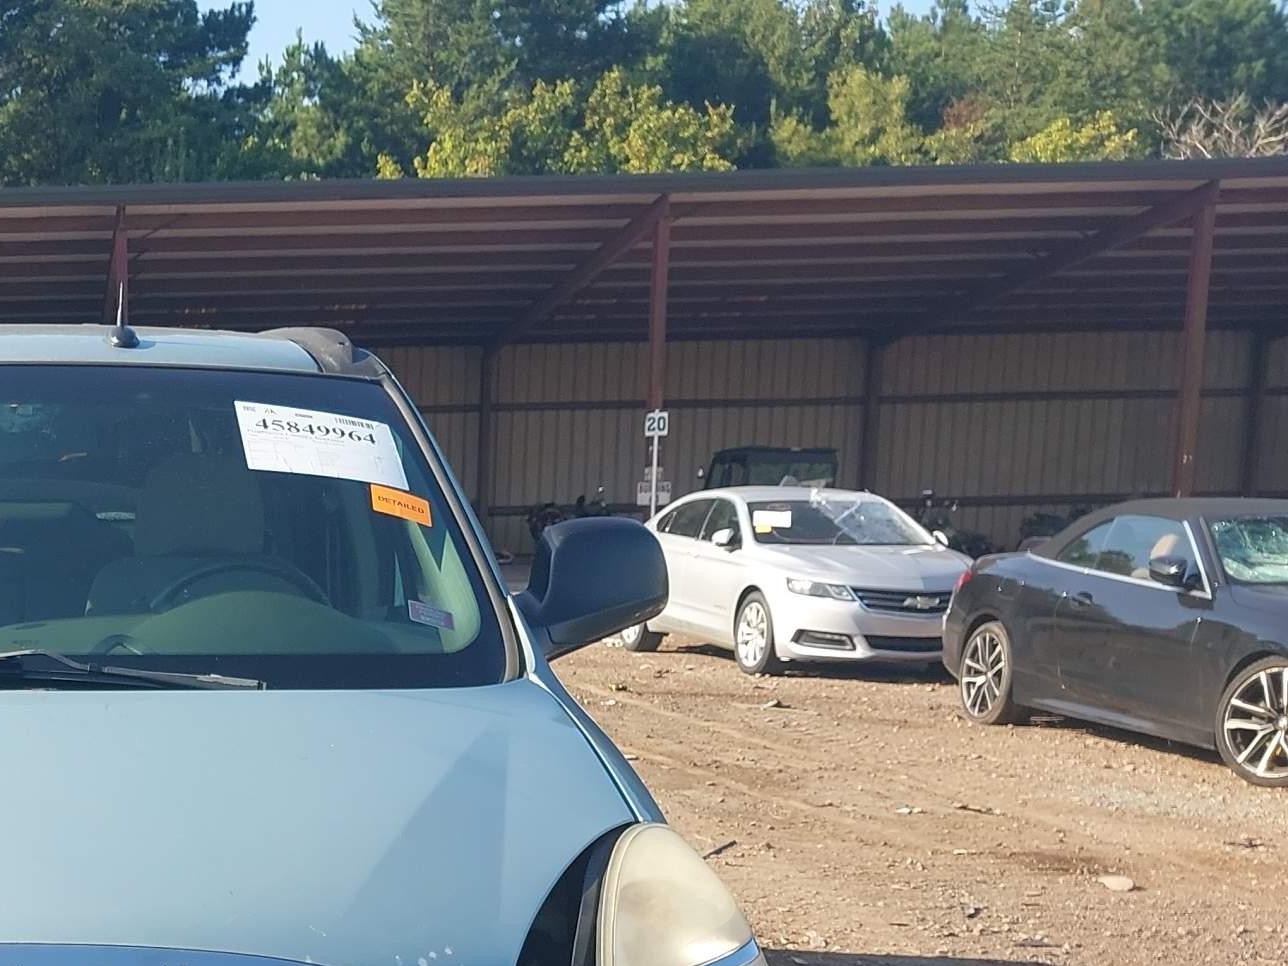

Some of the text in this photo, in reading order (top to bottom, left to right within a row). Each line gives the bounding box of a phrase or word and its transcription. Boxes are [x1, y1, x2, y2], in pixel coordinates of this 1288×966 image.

[255, 418, 376, 444] 45849964
[647, 416, 666, 431] 20
[377, 495, 424, 514] DETAILED
